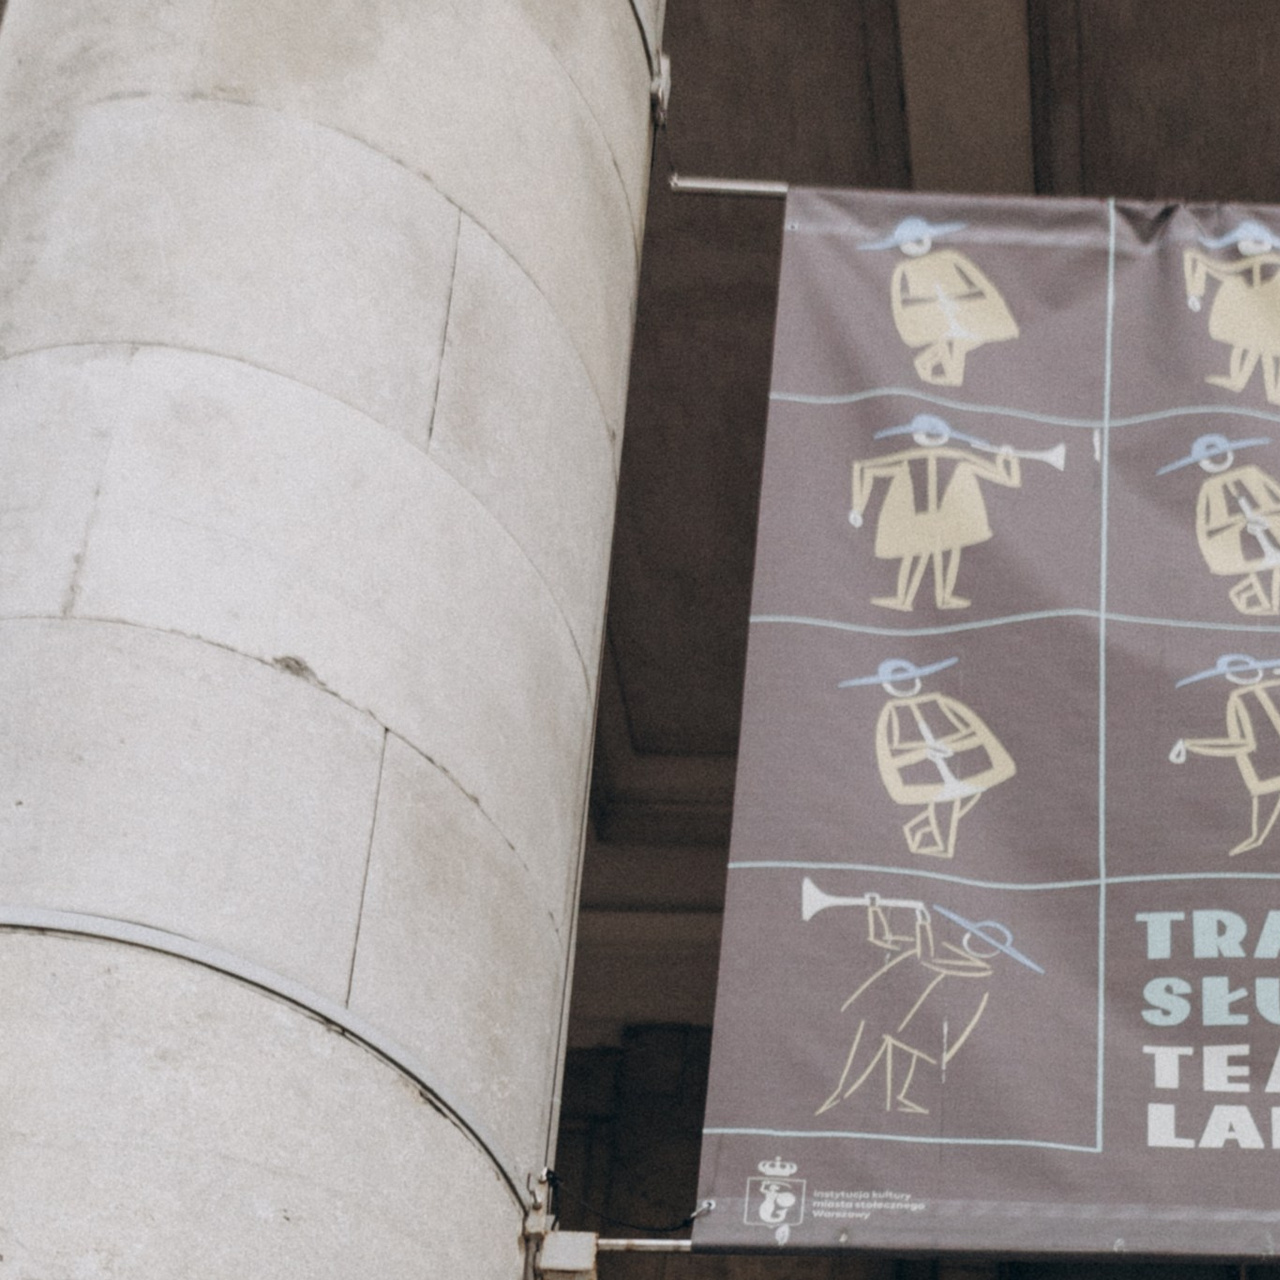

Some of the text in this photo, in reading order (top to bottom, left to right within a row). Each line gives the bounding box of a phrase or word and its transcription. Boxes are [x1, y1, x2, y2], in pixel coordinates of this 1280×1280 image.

[872, 1189, 911, 1201] kultury
[813, 1200, 853, 1209] miasta
[812, 1209, 870, 1220] Warszawy
